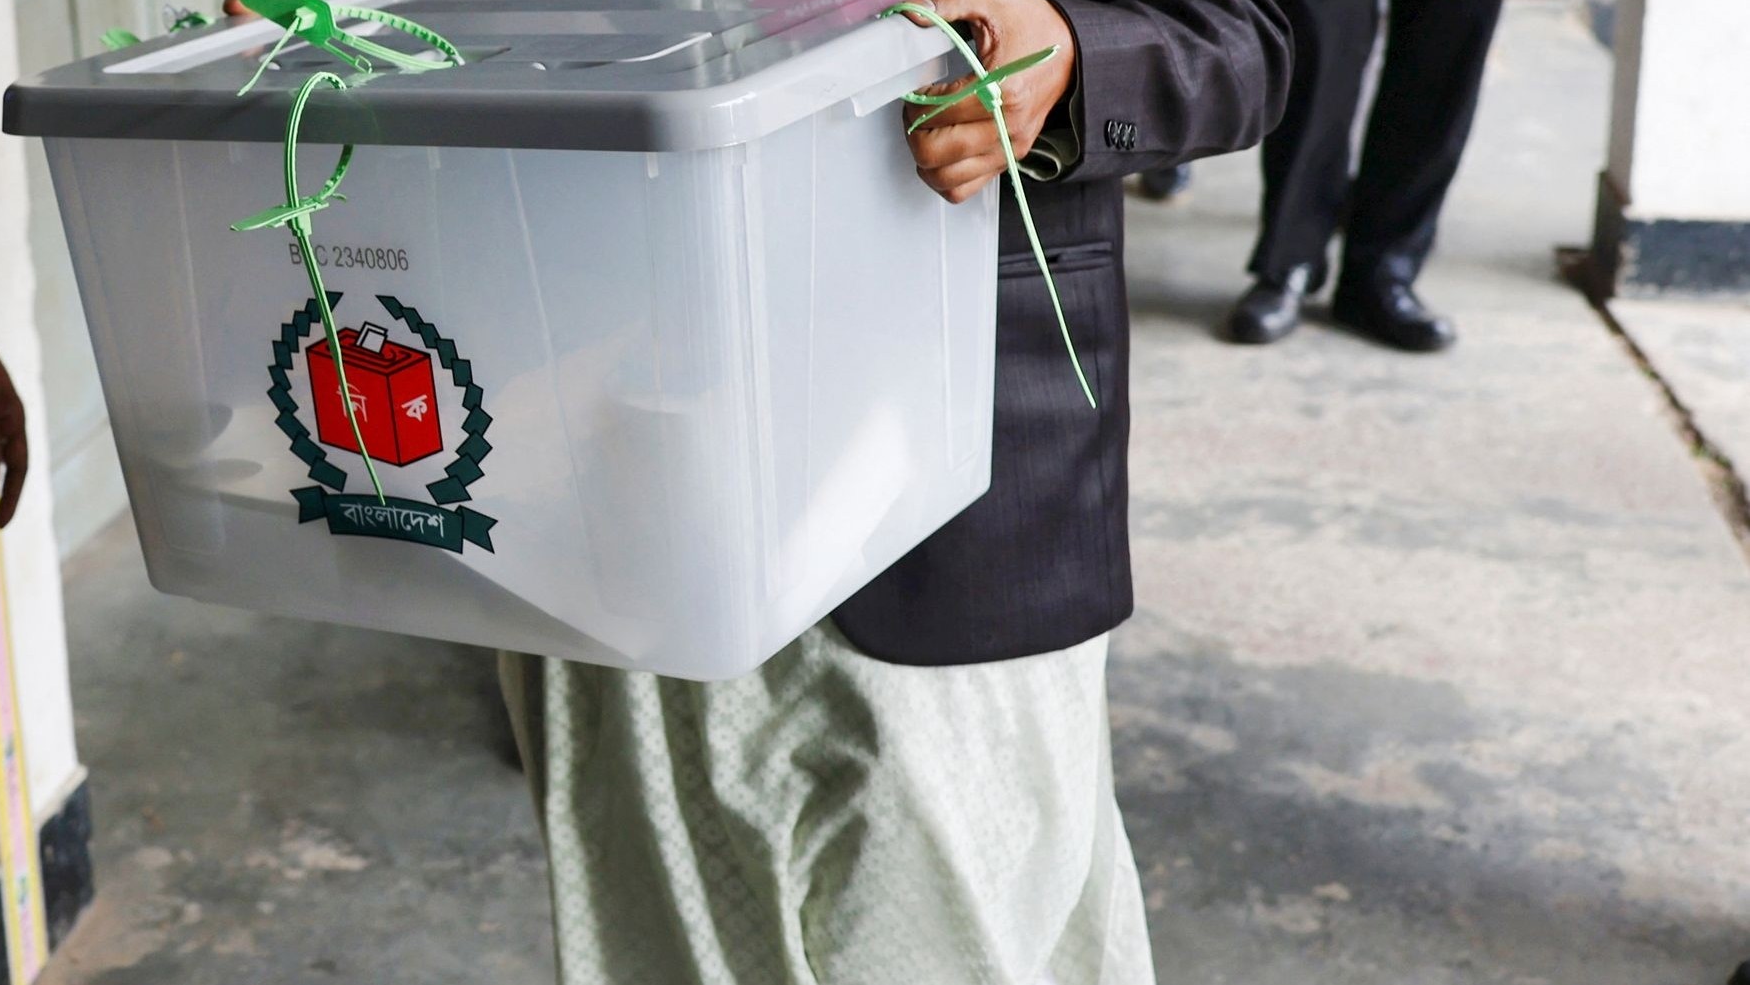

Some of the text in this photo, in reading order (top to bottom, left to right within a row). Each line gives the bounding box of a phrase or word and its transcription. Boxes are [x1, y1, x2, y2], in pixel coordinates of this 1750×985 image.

[289, 243, 409, 271] BC 2340806
[402, 394, 428, 422] ক
[340, 502, 446, 538] বাংলাদেশ
